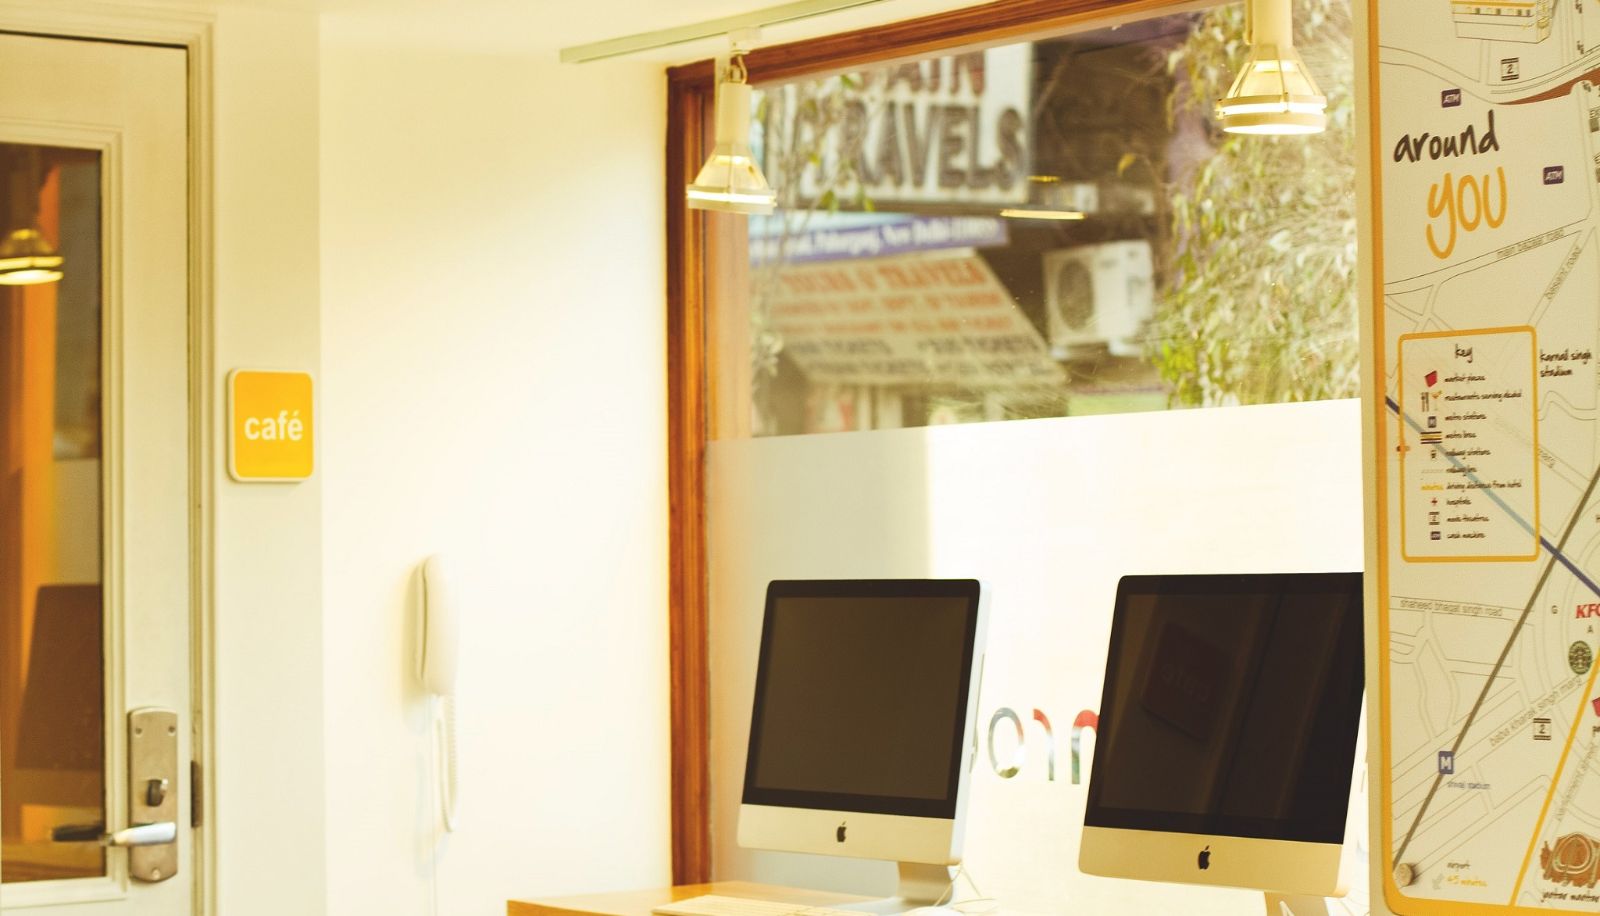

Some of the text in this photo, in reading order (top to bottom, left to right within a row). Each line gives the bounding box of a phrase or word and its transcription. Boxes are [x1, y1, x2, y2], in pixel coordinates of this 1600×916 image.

[1394, 109, 1500, 162] around
[1426, 166, 1508, 260] you
[1455, 344, 1473, 363] key
[1571, 348, 1592, 364] singh
[1540, 365, 1573, 377] stadium
[244, 409, 304, 441] café
[1441, 756, 1452, 770] M
